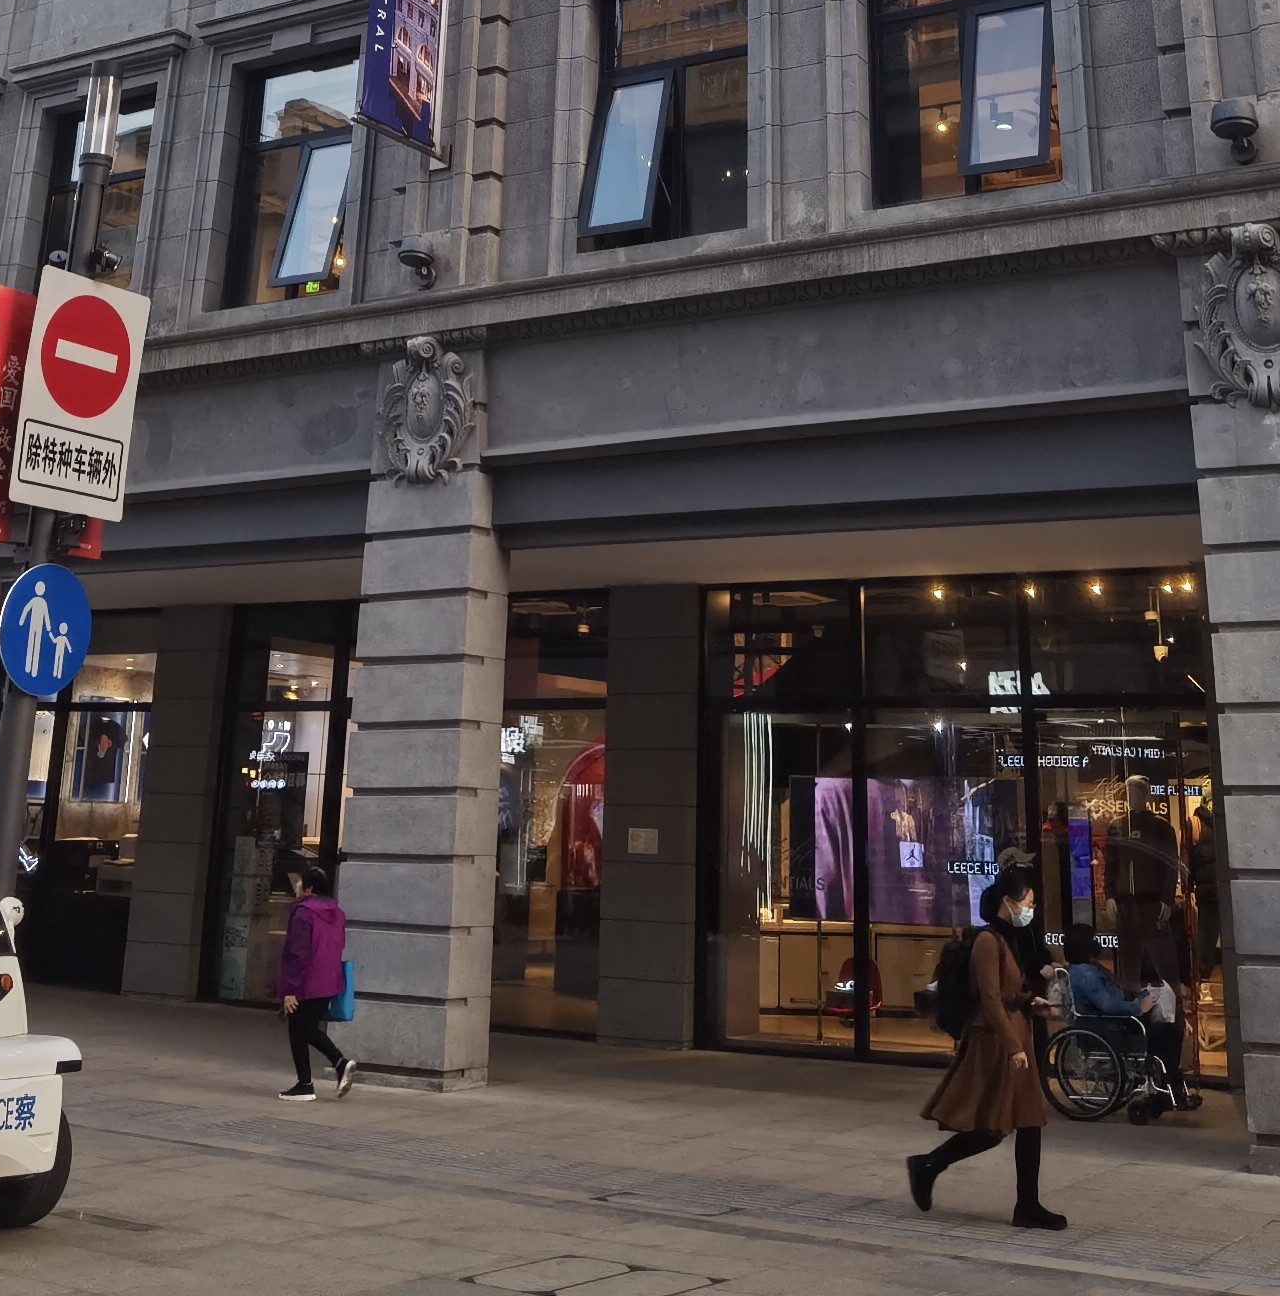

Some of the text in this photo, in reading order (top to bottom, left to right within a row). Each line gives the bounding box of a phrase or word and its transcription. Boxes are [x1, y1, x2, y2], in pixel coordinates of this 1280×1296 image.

[0, 355, 21, 410] 爱国
[24, 432, 117, 489] 除特种车辆外
